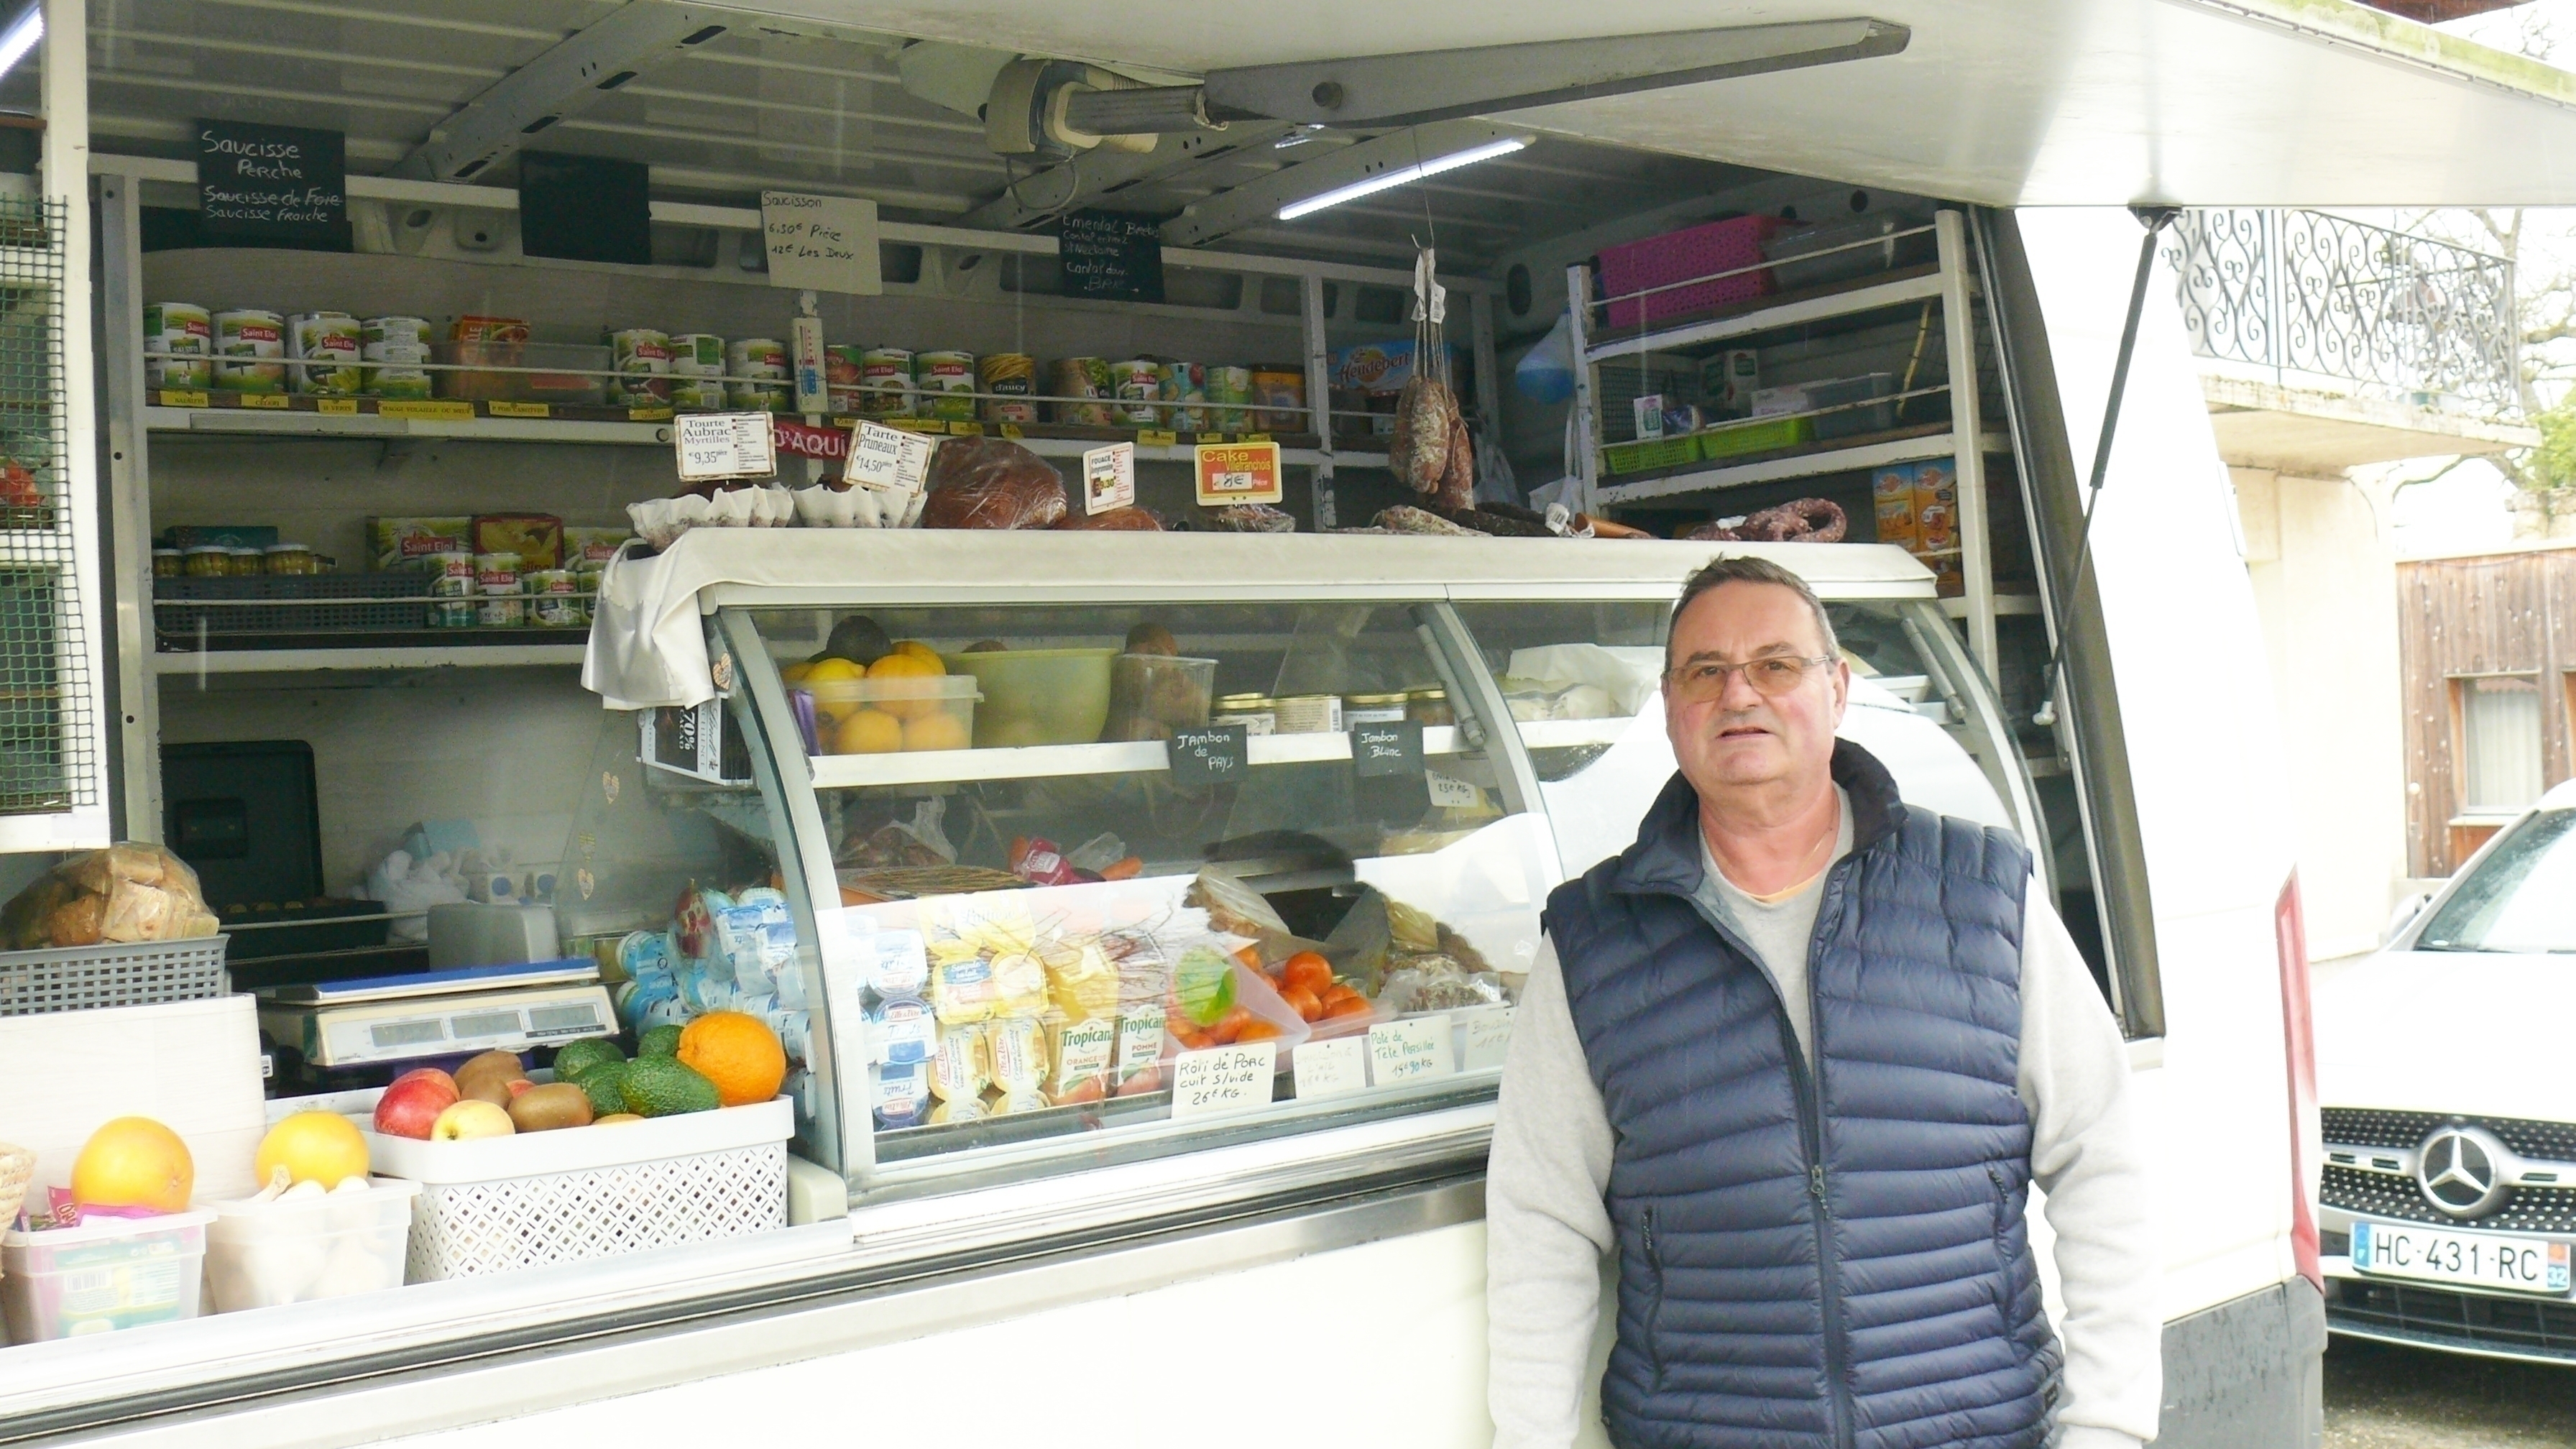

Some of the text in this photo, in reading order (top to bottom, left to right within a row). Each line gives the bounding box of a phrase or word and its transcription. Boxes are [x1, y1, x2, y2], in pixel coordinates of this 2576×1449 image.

[201, 130, 300, 159] Saucisse
[204, 185, 343, 206] Saucisse de Foie
[763, 190, 822, 208] Saucisson
[206, 205, 271, 221] Saucisse
[799, 245, 819, 258] Les
[242, 328, 277, 339] Saint Eloi
[323, 339, 343, 349] Saint
[1335, 353, 1411, 382] Heudebert
[686, 420, 725, 428] Tourte
[683, 428, 731, 437] Aubrac
[865, 426, 898, 442] Tarte
[684, 436, 730, 446] Myrtilles
[858, 433, 898, 456] Pruneaux
[1092, 455, 1111, 465] FOUACE
[1202, 450, 1248, 462] Cake
[1223, 473, 1244, 487] 8€
[404, 542, 432, 552] Saint
[480, 574, 514, 583] Saint Eloi
[684, 711, 696, 751] 70%
[1361, 732, 1398, 745] Jambon
[1195, 745, 1208, 757] de
[1208, 756, 1233, 773] PAYS
[1120, 1016, 1165, 1034] Tropican
[1393, 1029, 1403, 1041] de
[1132, 1042, 1157, 1052] POMME
[1375, 1045, 1399, 1060] Tête
[1067, 1054, 1098, 1066] ORANGE
[1179, 1059, 1209, 1077] Rôti
[1213, 1057, 1228, 1071] de
[1179, 1074, 1207, 1088] cuit
[2548, 1266, 2568, 1285] 32
